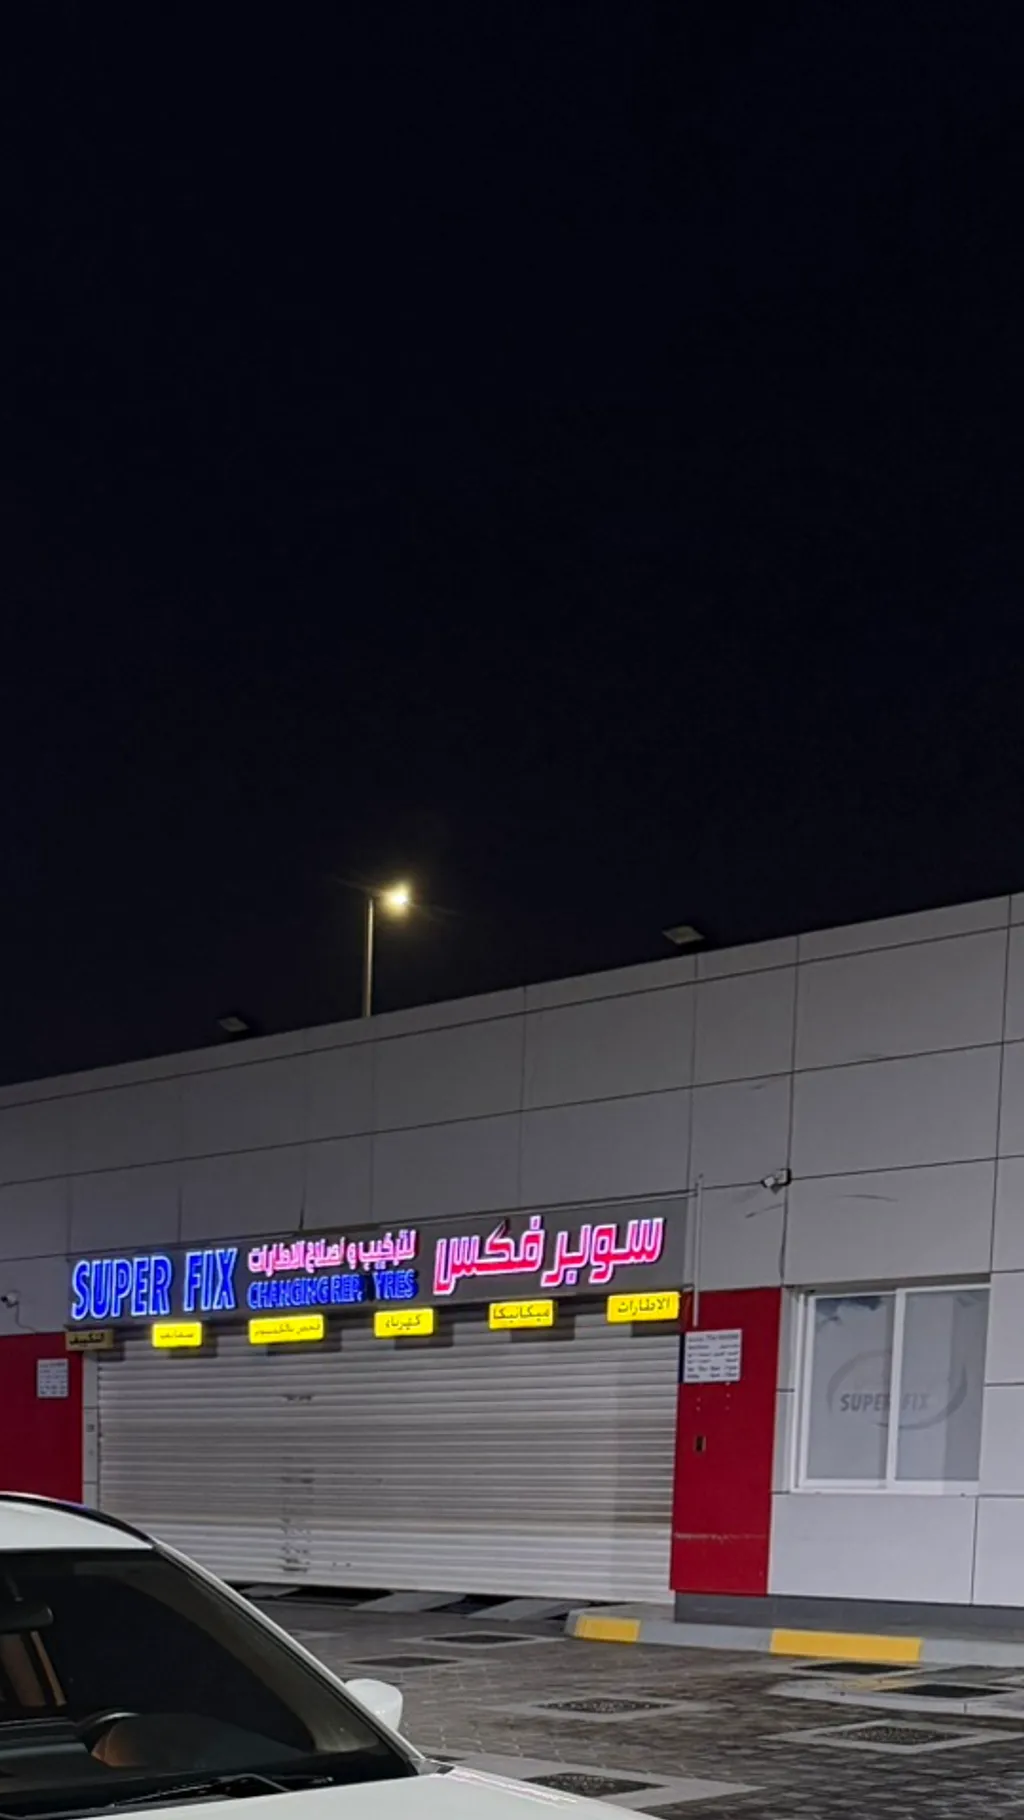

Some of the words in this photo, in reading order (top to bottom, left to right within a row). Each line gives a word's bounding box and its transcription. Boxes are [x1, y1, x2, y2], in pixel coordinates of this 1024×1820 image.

[71, 1255, 172, 1320] SUPER
[183, 1247, 238, 1312] FIX
[433, 1215, 545, 1295] فكس
[541, 1217, 663, 1287] سوبر
[247, 1275, 328, 1309] CHANGING
[840, 1394, 890, 1412] SUPE
